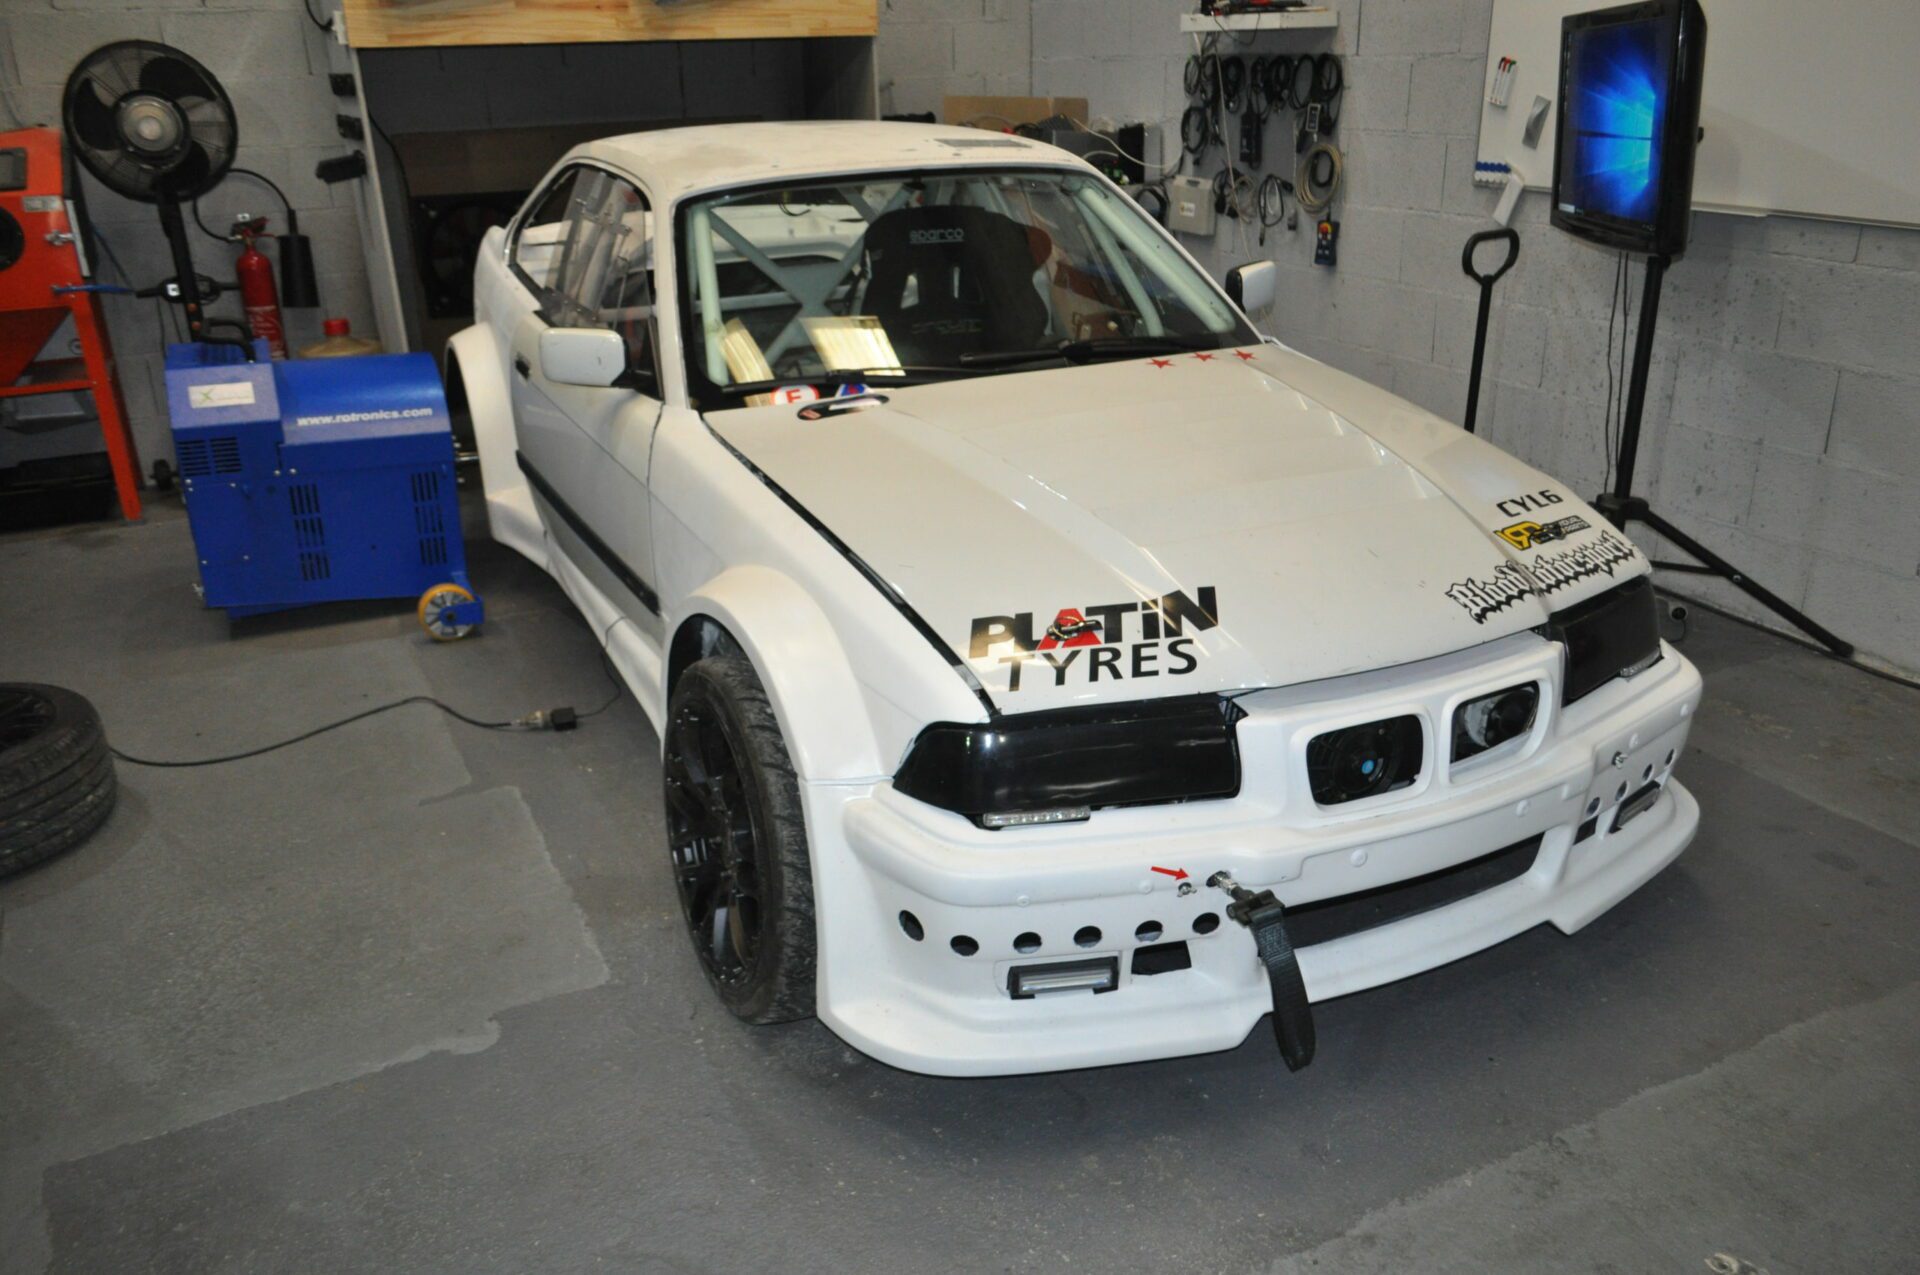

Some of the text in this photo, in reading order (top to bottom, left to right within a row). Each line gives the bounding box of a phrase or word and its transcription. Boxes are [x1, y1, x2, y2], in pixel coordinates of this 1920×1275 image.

[910, 228, 965, 241] sparco
[297, 407, 433, 426] www.rotronics.com
[1496, 489, 1564, 518] CYL6
[998, 638, 1198, 692] TYRES
